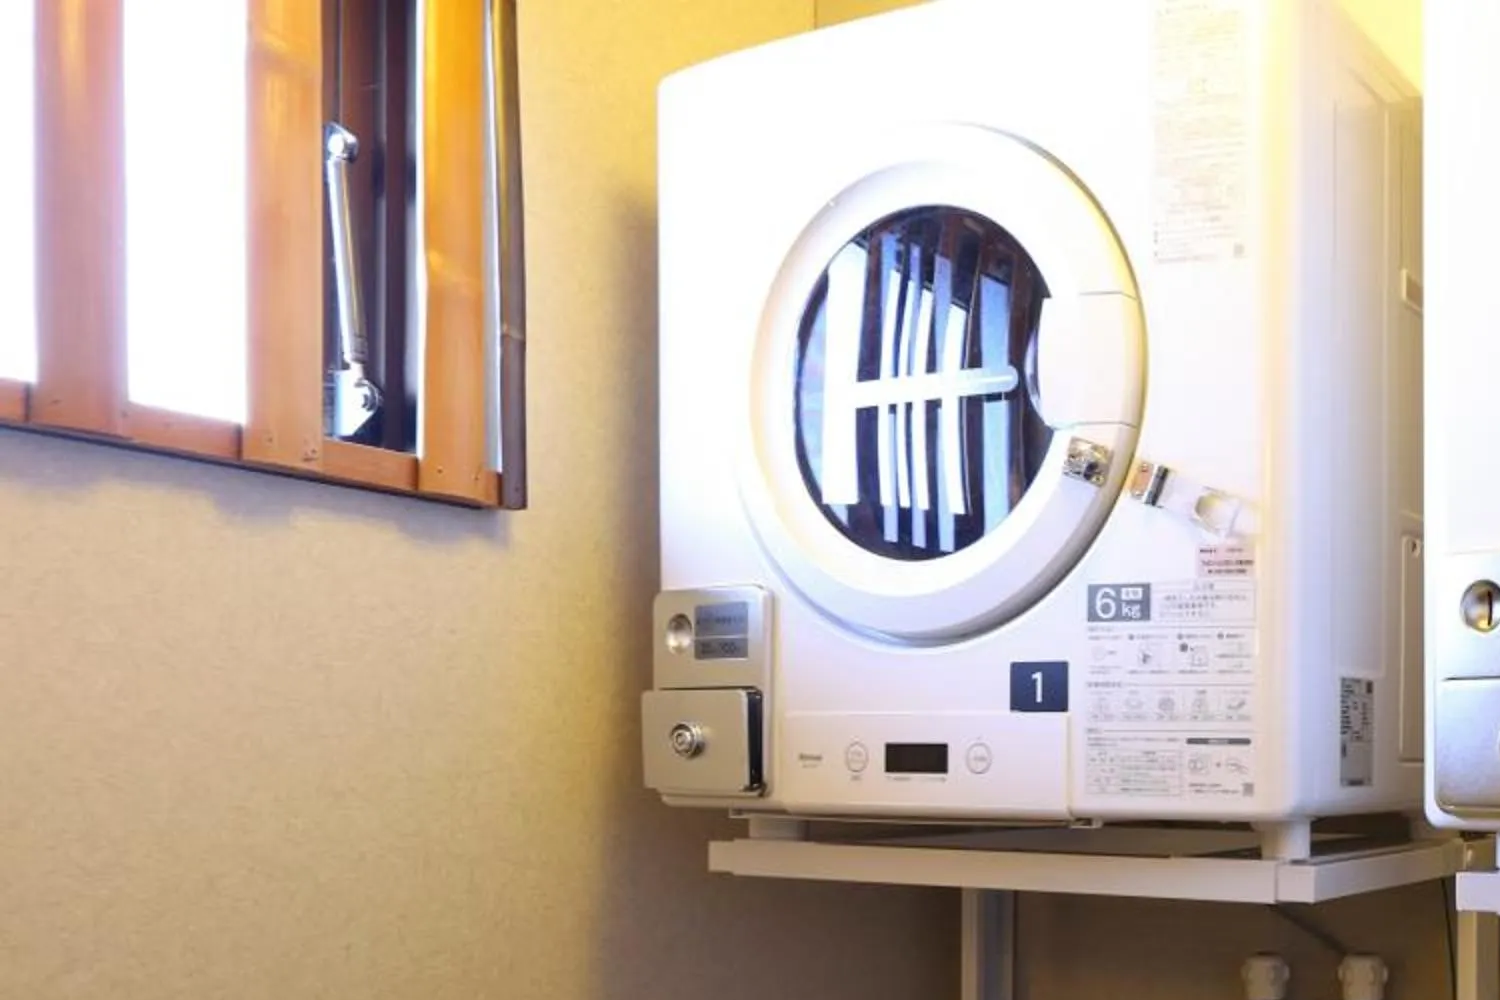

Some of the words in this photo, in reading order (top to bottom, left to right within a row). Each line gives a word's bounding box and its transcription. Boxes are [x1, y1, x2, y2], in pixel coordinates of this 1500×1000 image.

[1095, 587, 1117, 619] 6
[1122, 603, 1142, 619] kg
[1031, 672, 1043, 703] 1
